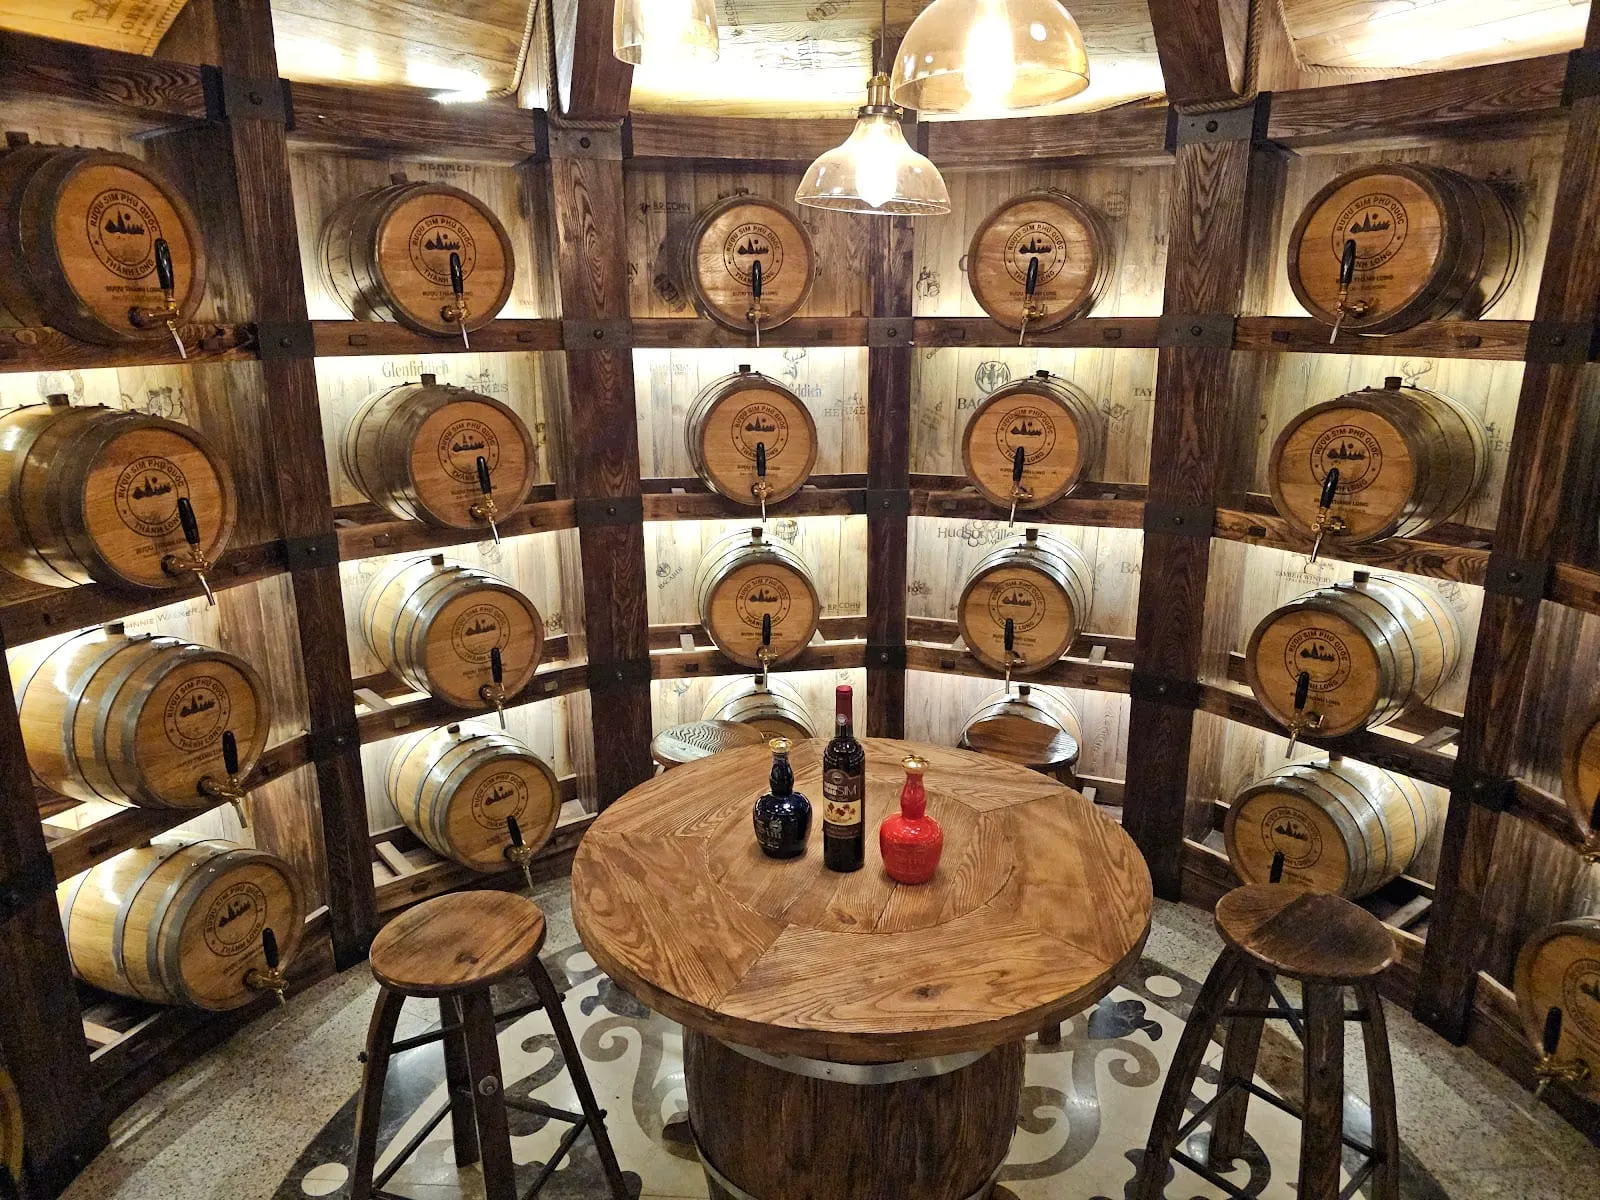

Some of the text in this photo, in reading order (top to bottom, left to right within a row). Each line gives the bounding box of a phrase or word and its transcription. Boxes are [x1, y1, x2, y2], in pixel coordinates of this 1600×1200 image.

[102, 193, 119, 205] SIM
[1355, 197, 1372, 209] SIM
[424, 218, 439, 228] SIM
[1022, 224, 1036, 233] SIM
[738, 226, 751, 235] SIM
[1370, 248, 1393, 266] LONG
[1332, 428, 1347, 437] SIM
[130, 461, 146, 474] SIM
[837, 784, 857, 796] SIM
